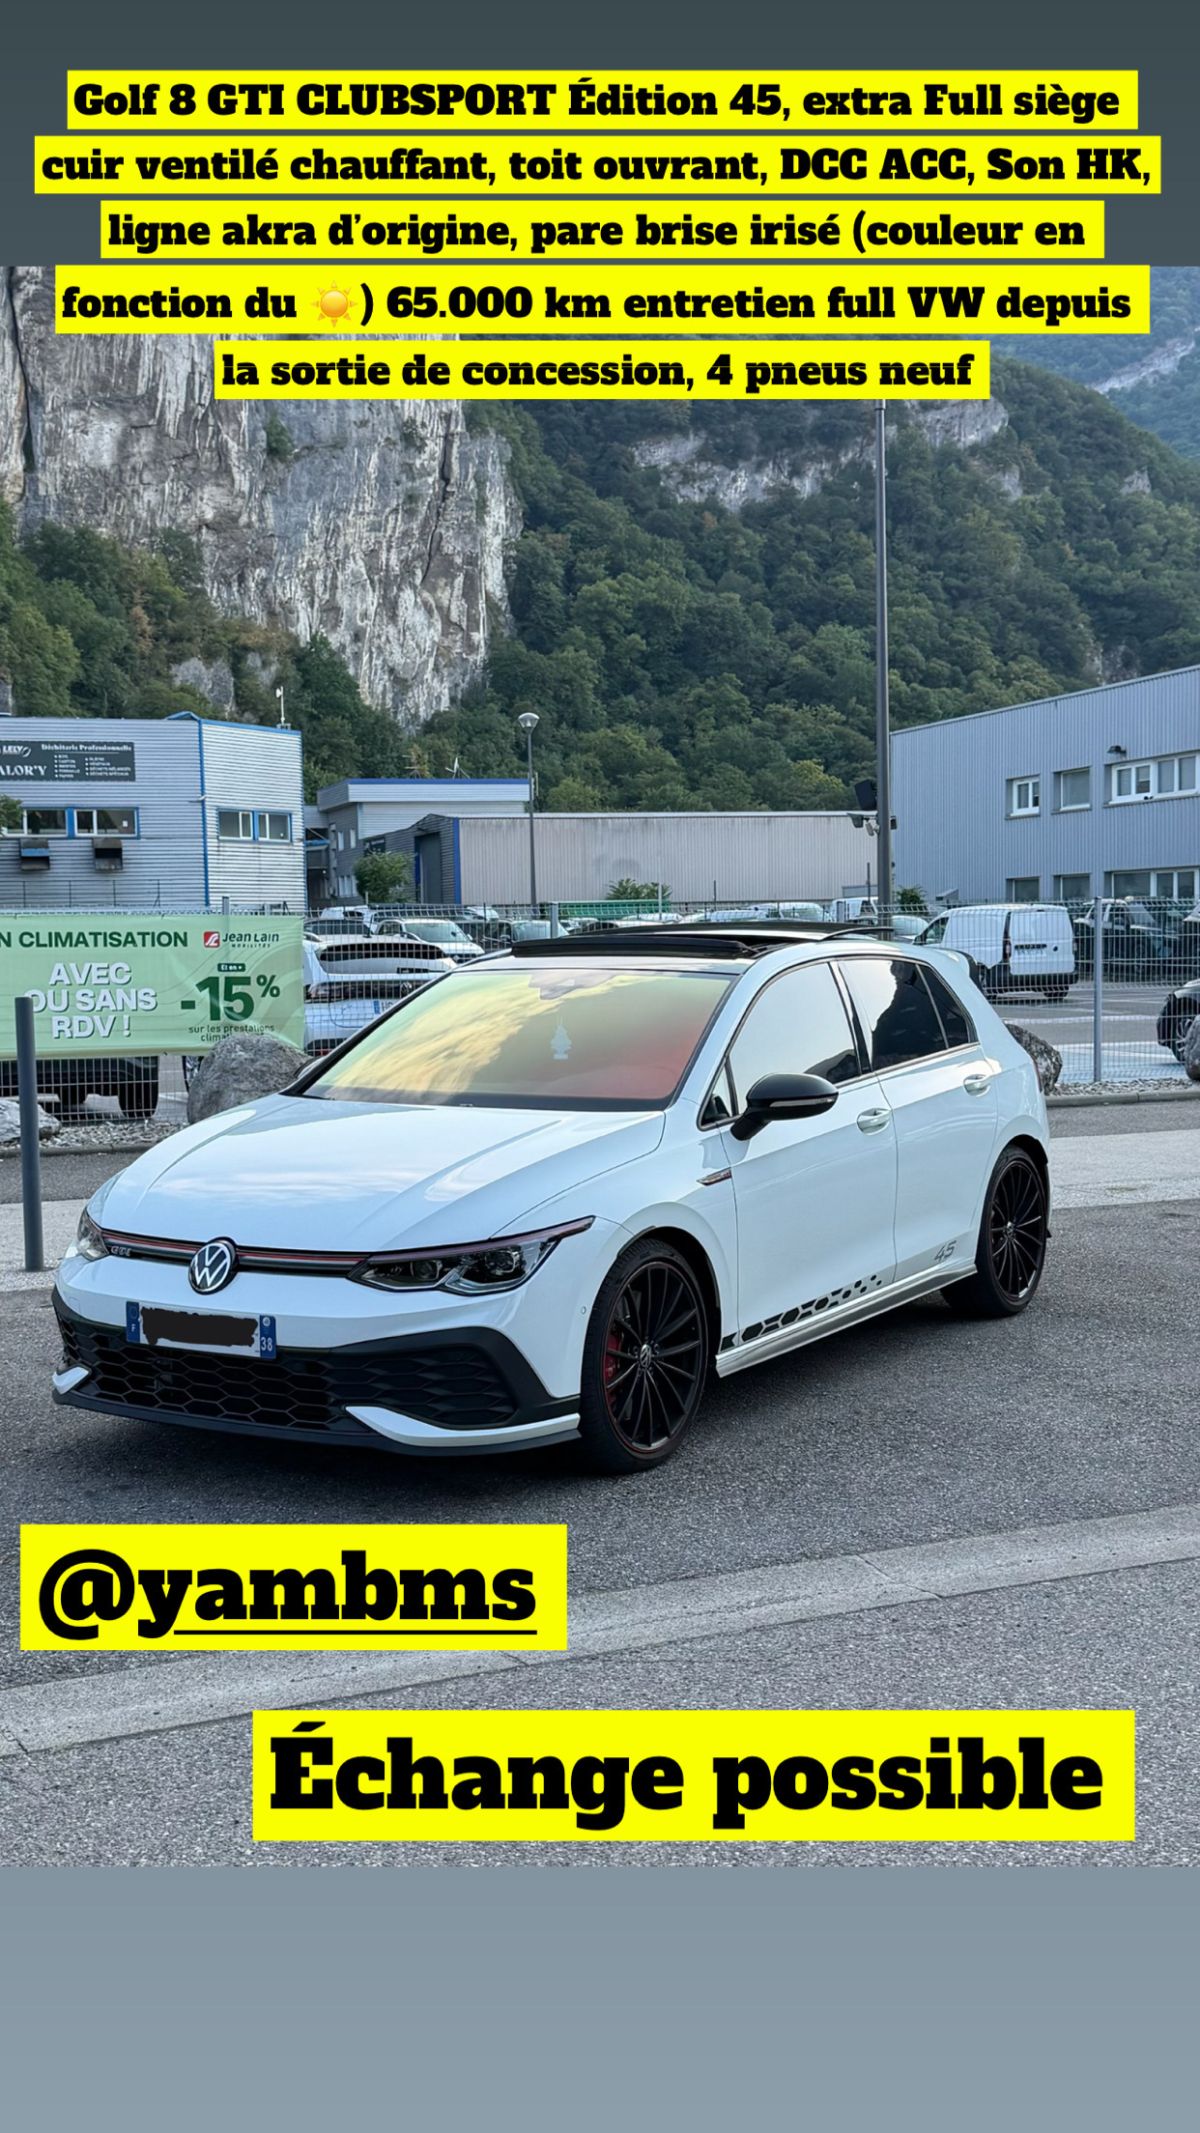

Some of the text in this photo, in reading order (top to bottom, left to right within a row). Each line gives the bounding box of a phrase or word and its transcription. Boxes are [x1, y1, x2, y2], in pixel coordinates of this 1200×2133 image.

[18, 931, 188, 948] CLIMATISATION
[222, 932, 280, 943] Jean Lain
[49, 962, 132, 986] AVEC
[23, 988, 158, 1013] OU SANS
[52, 1015, 131, 1039] RDV !
[188, 1026, 205, 1034] sur
[207, 1025, 221, 1034] les
[934, 1240, 957, 1262] 45
[260, 1336, 273, 1352] 38
